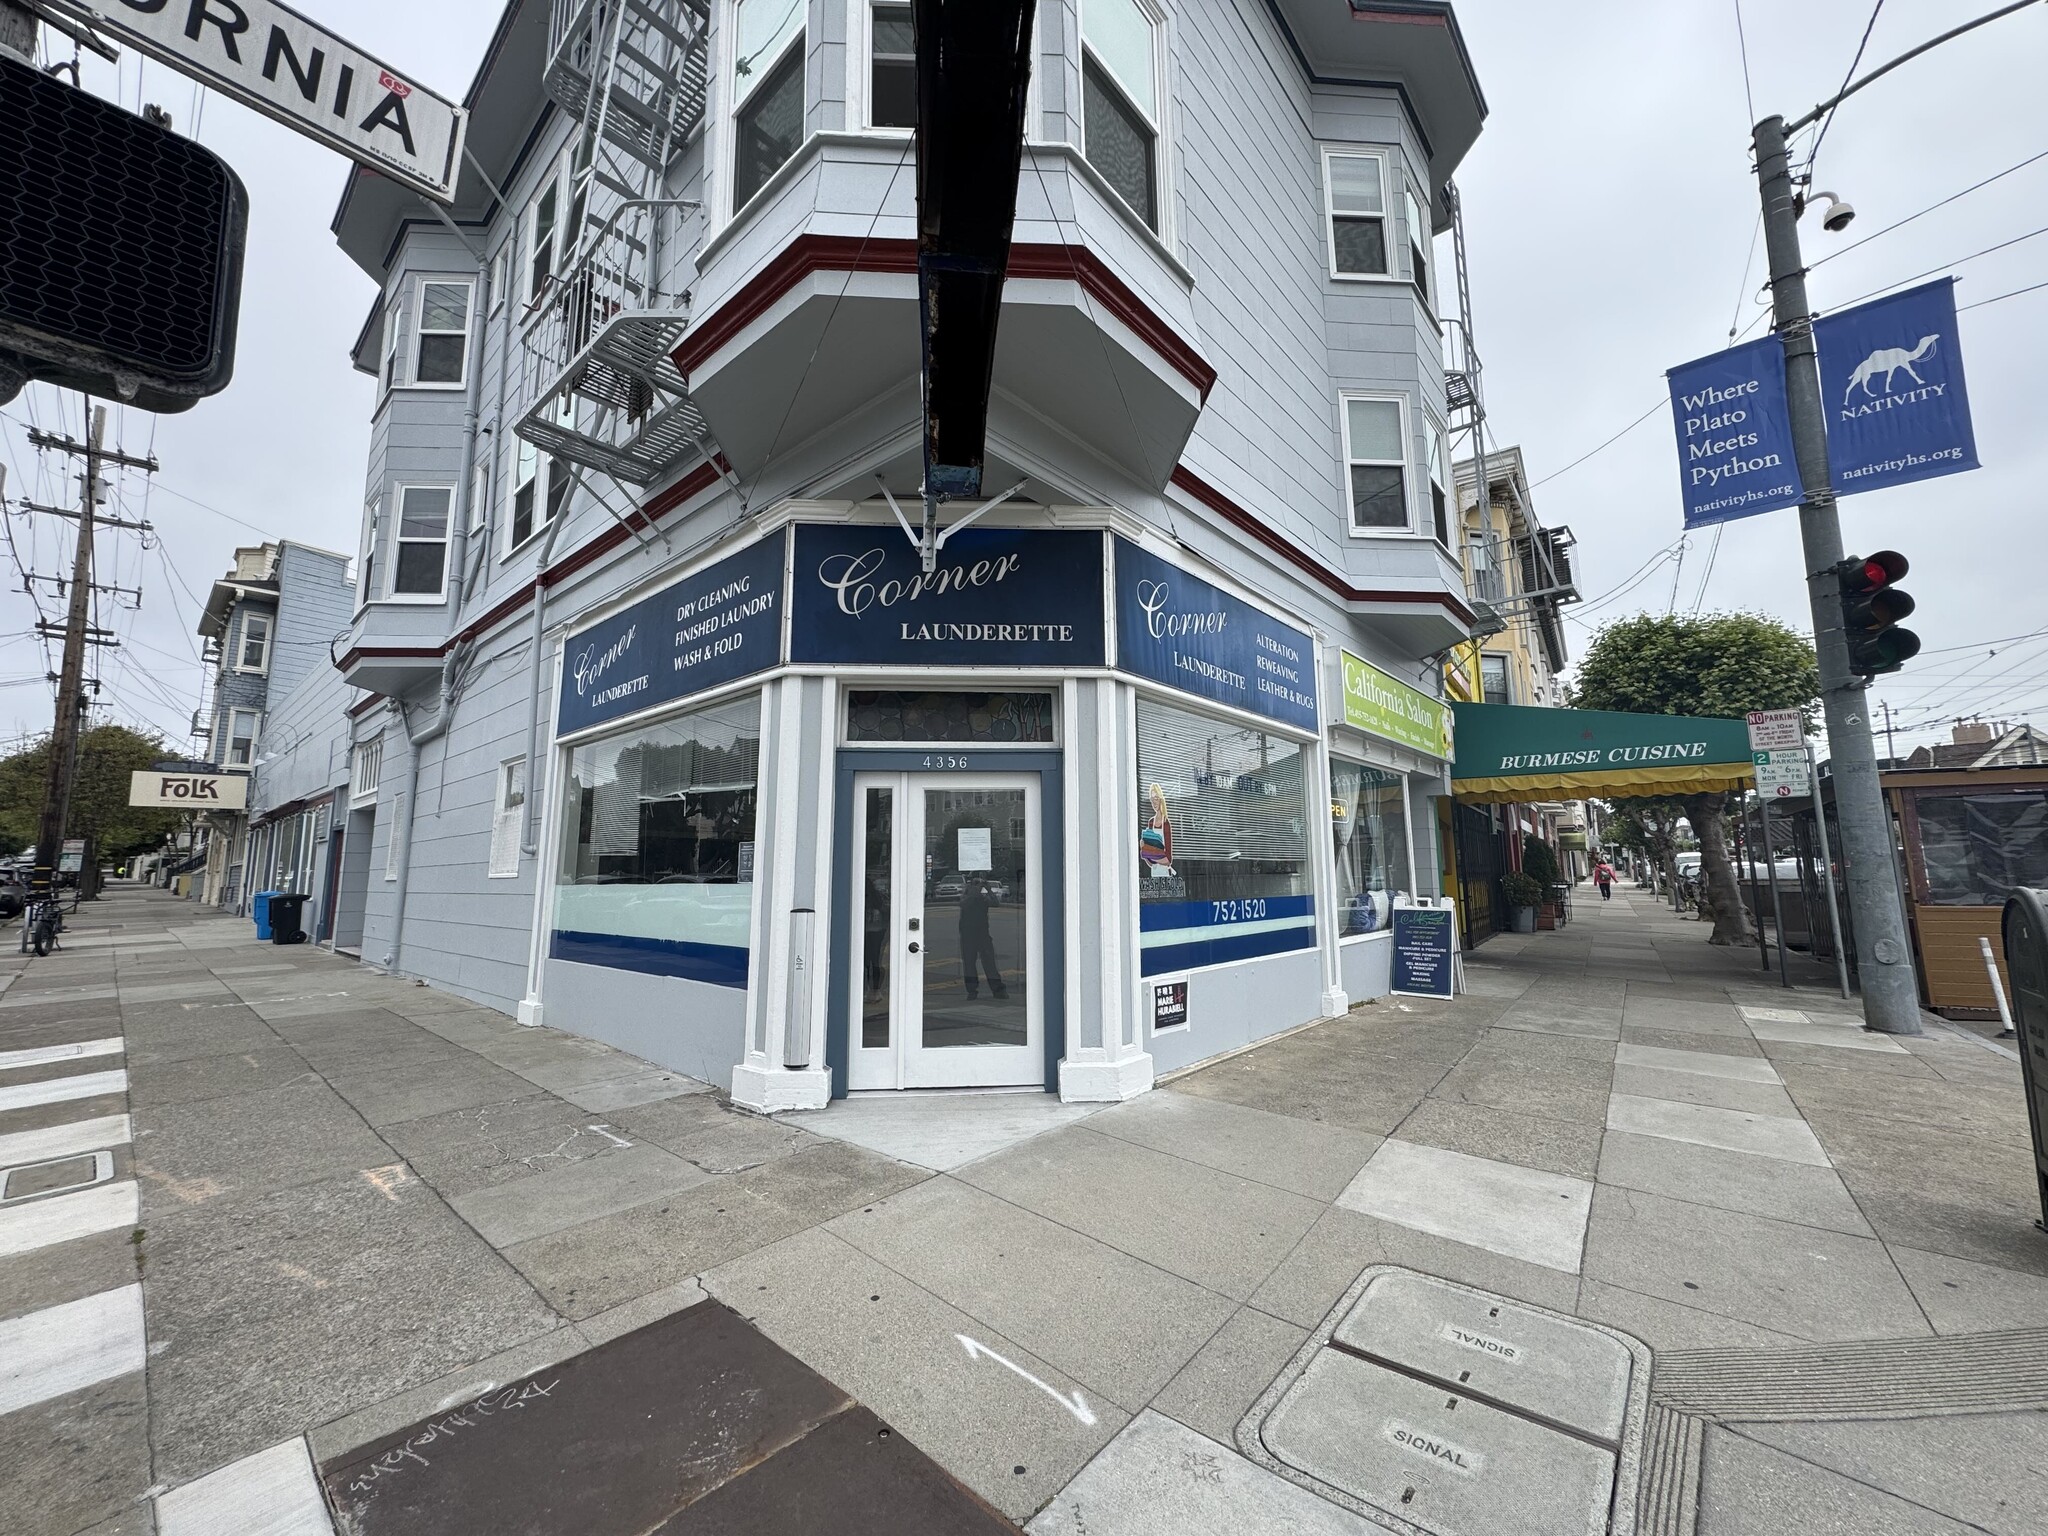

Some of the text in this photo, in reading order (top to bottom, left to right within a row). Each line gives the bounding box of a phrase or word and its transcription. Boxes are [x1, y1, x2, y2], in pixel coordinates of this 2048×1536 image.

[1680, 380, 1759, 412] Where
[1840, 383, 1946, 421] NATIVITY
[1684, 410, 1747, 437] Plato
[1688, 432, 1758, 462] Meets
[1842, 447, 1963, 480] nativityhs.org
[1690, 453, 1783, 487] Python
[1693, 485, 1794, 514] nativityhs.org
[677, 575, 750, 622] DRY CLEANING
[818, 548, 1020, 620] Corner
[675, 590, 775, 647] FINISHED LAUNDRY
[1136, 579, 1228, 645] Corner
[900, 622, 1074, 642] LAUNDERETTE
[1256, 633, 1299, 663] ALTERATION
[573, 624, 636, 698] Corner
[674, 632, 743, 671] WASH & FOLD
[1174, 651, 1246, 690] LAUNDERETTE
[1256, 655, 1299, 683] REWEAVING
[592, 675, 649, 708] LAUNDERETTE
[1257, 677, 1314, 710] LEATHER & RUGS
[1344, 661, 1405, 717] California
[1406, 693, 1433, 730] Salon
[1748, 712, 1798, 724] NO PARKING
[922, 756, 968, 768] 4356
[1499, 742, 1707, 770] BURMESE CUISINE
[1756, 753, 1767, 764] 2
[1158, 996, 1174, 1006] MARIE
[1452, 1329, 1516, 1358] SIGNAL
[1393, 1430, 1468, 1469] SIGNAL
